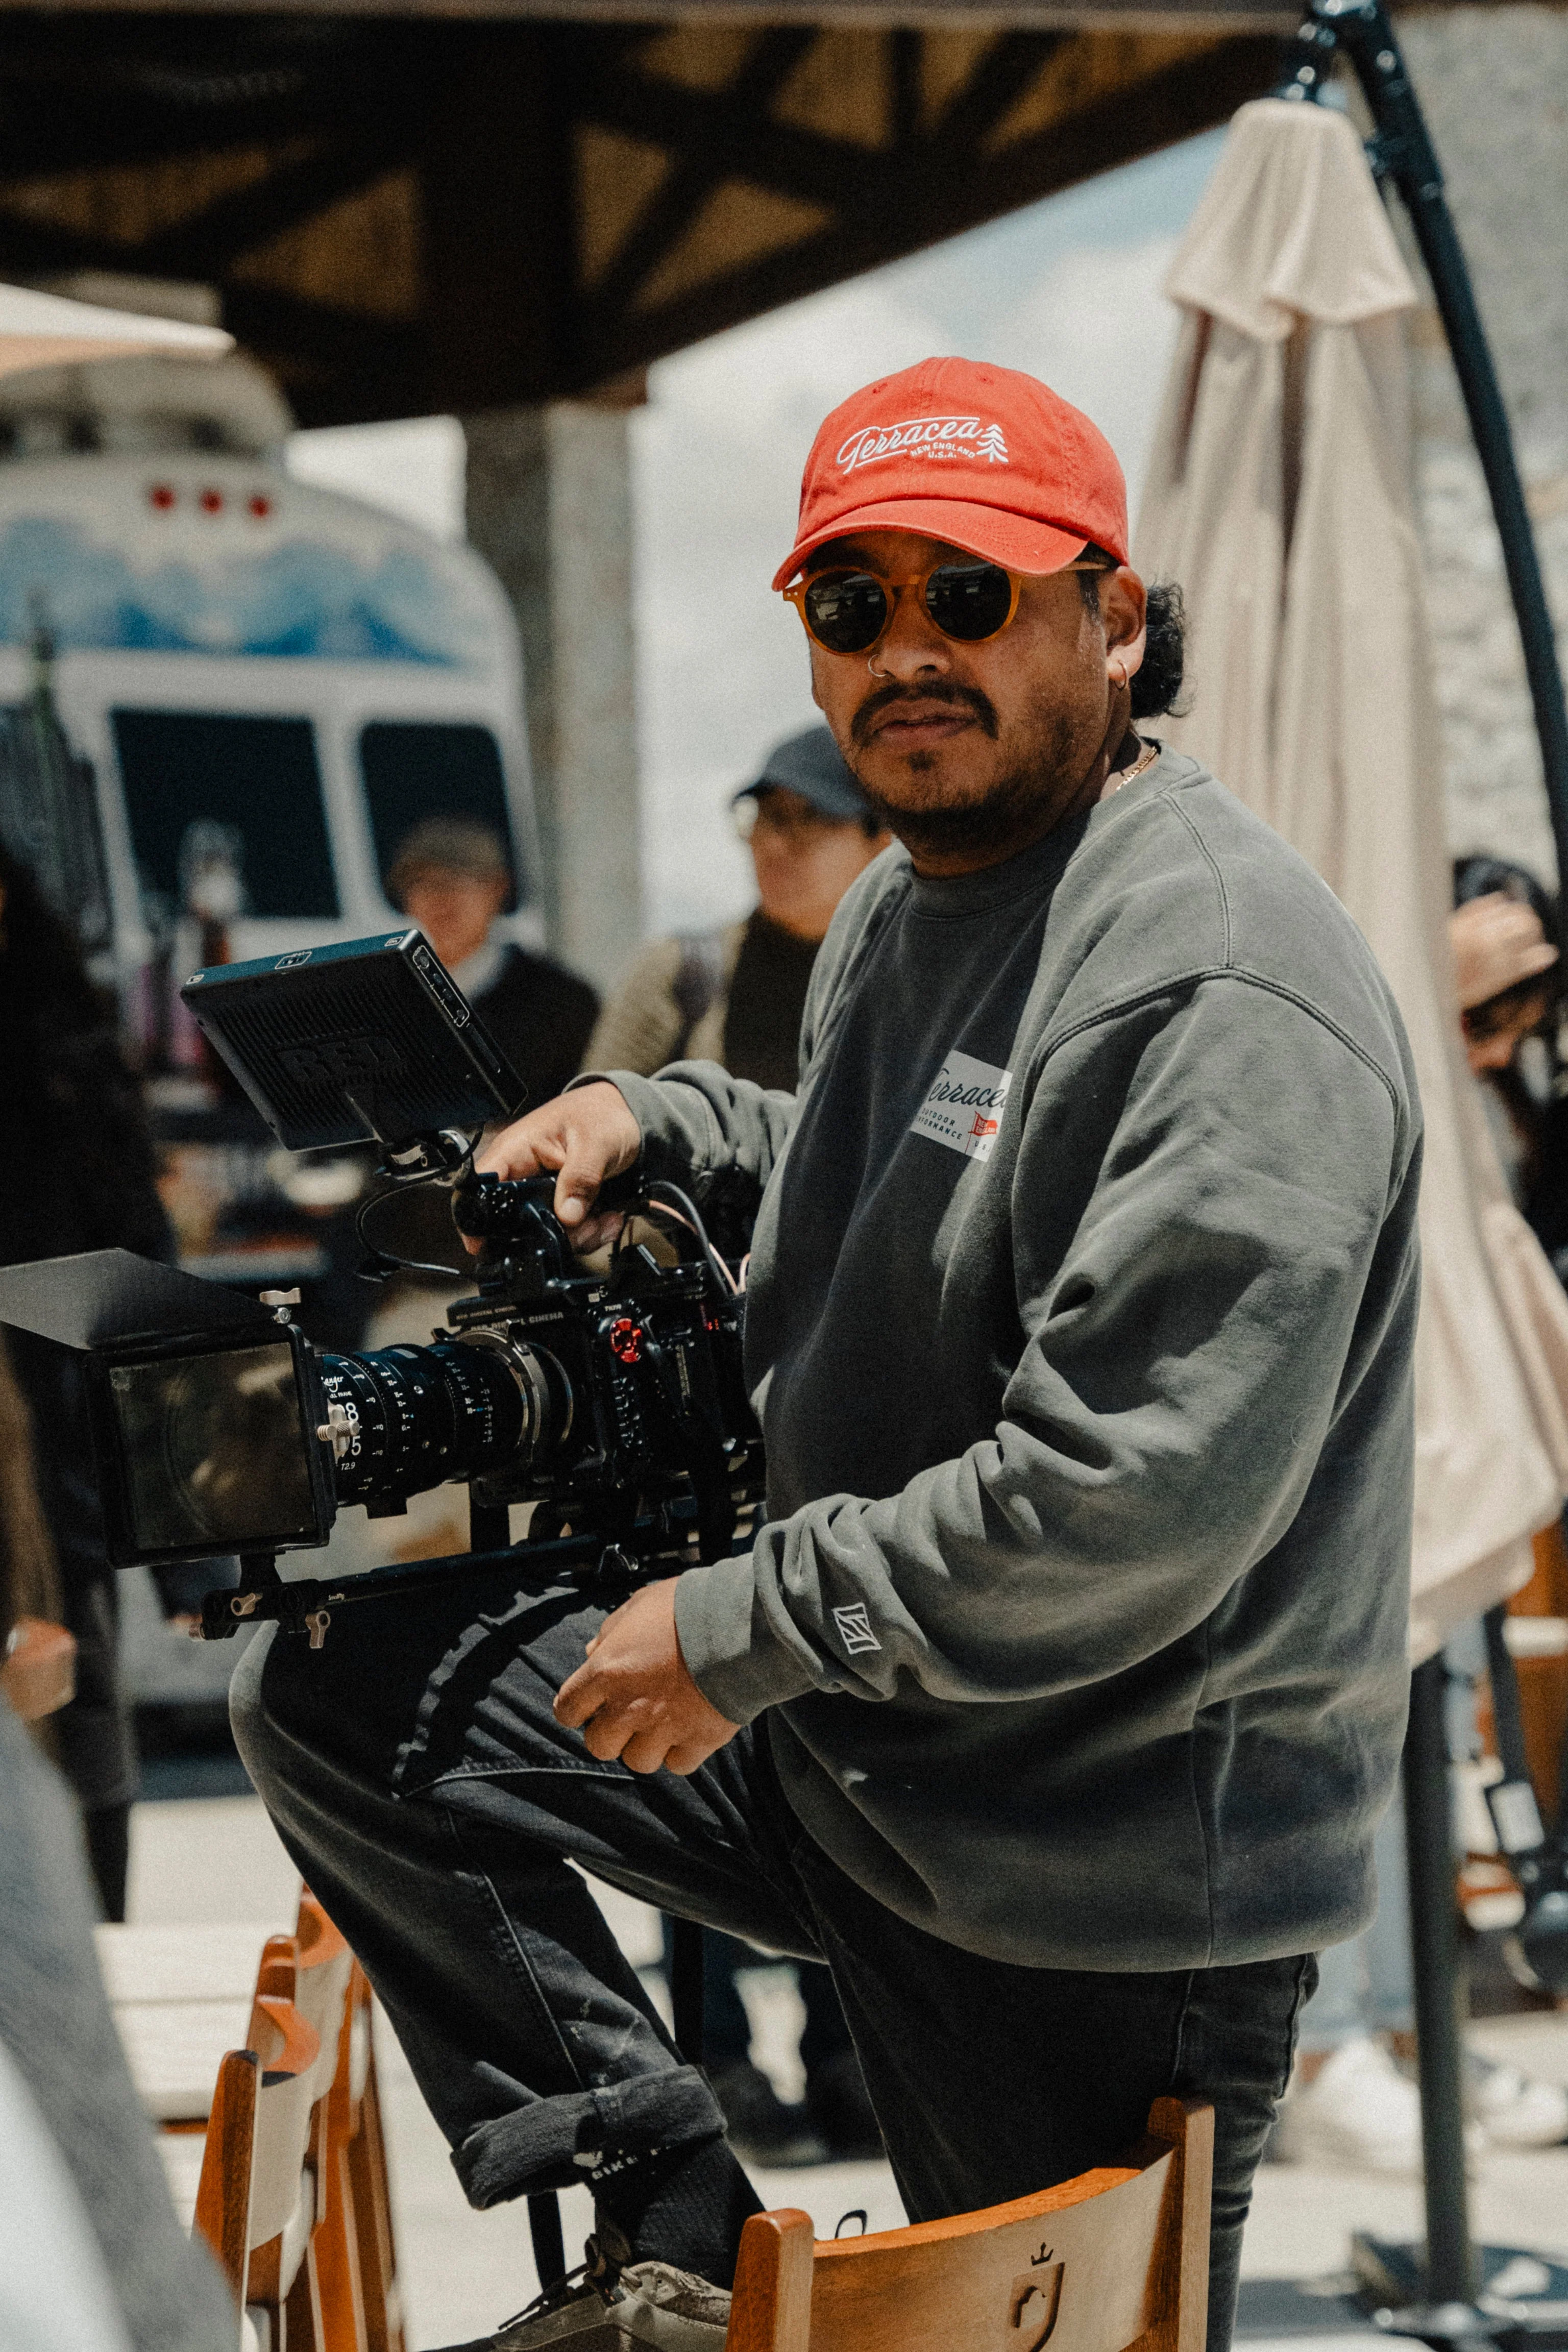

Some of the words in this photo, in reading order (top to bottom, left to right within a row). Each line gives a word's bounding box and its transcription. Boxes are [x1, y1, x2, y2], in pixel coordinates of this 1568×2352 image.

[836, 416, 983, 475] Terracea
[910, 444, 931, 457] NEW
[933, 442, 975, 458] ENGLAND
[928, 1068, 1007, 1108] errace
[529, 1311, 564, 1324] CINEMA
[341, 1461, 356, 1471] T2.9
